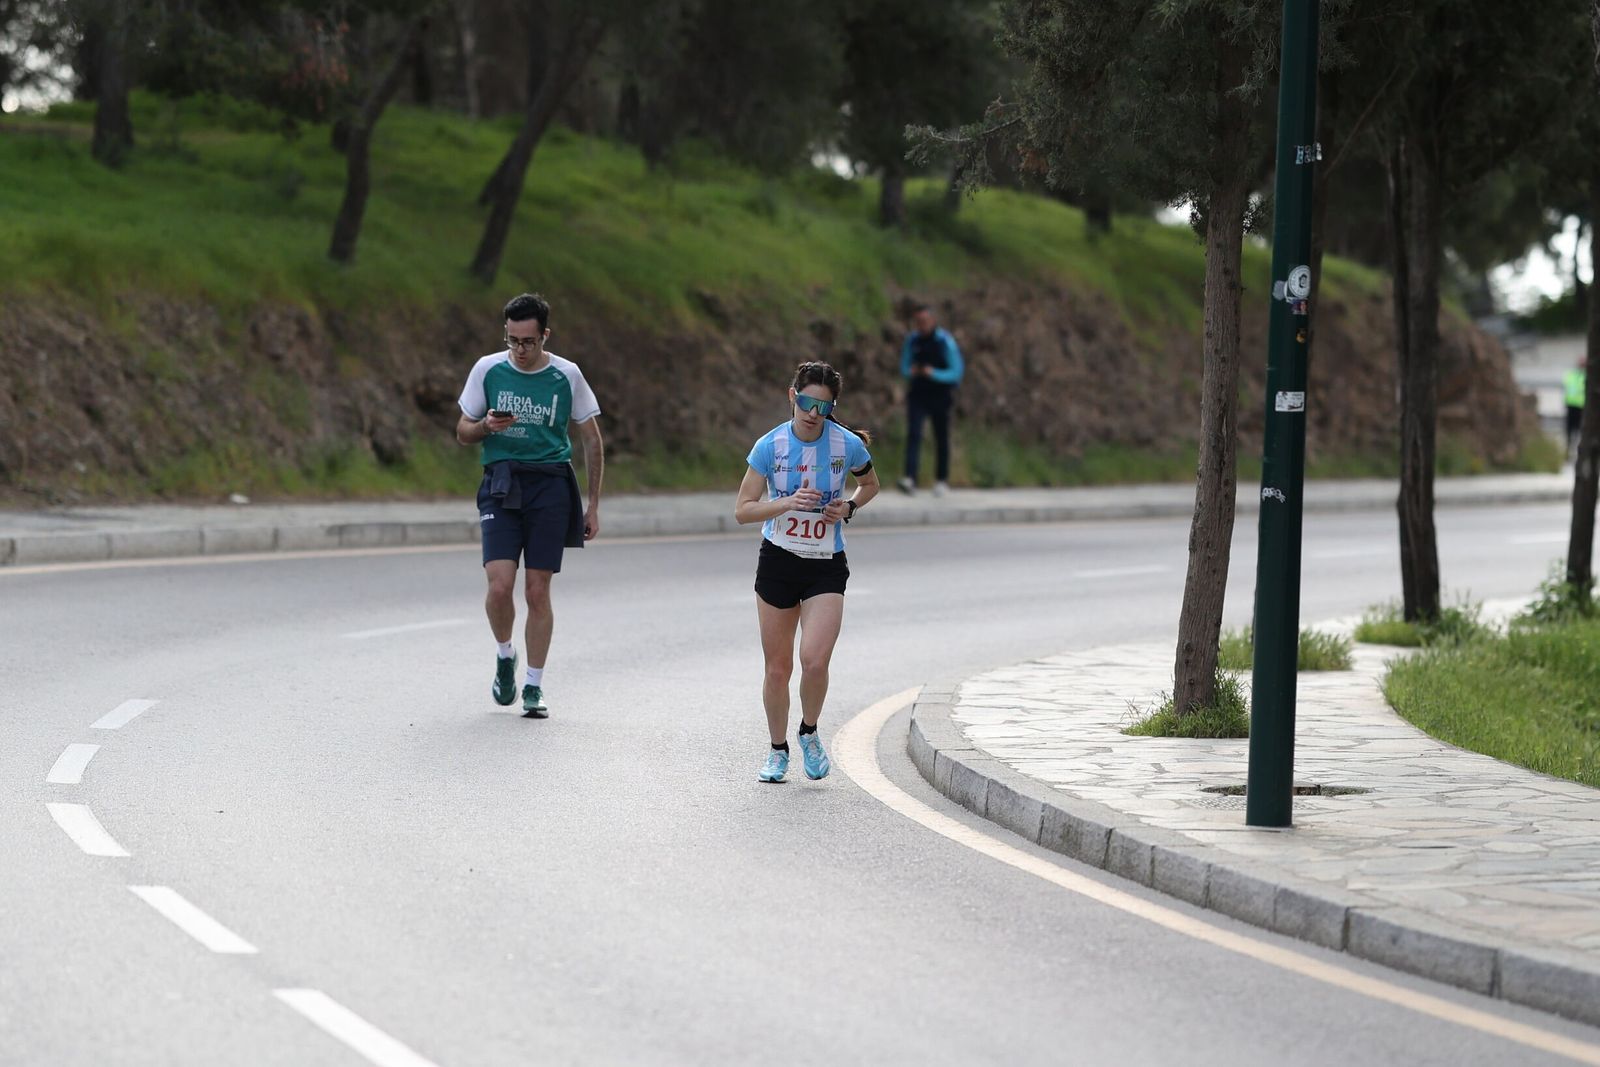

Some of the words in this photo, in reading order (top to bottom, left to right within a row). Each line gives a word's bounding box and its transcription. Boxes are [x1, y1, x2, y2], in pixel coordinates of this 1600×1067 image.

[498, 395, 532, 406] MEDIA
[497, 403, 551, 416] MARATÓN
[785, 517, 826, 540] 210
